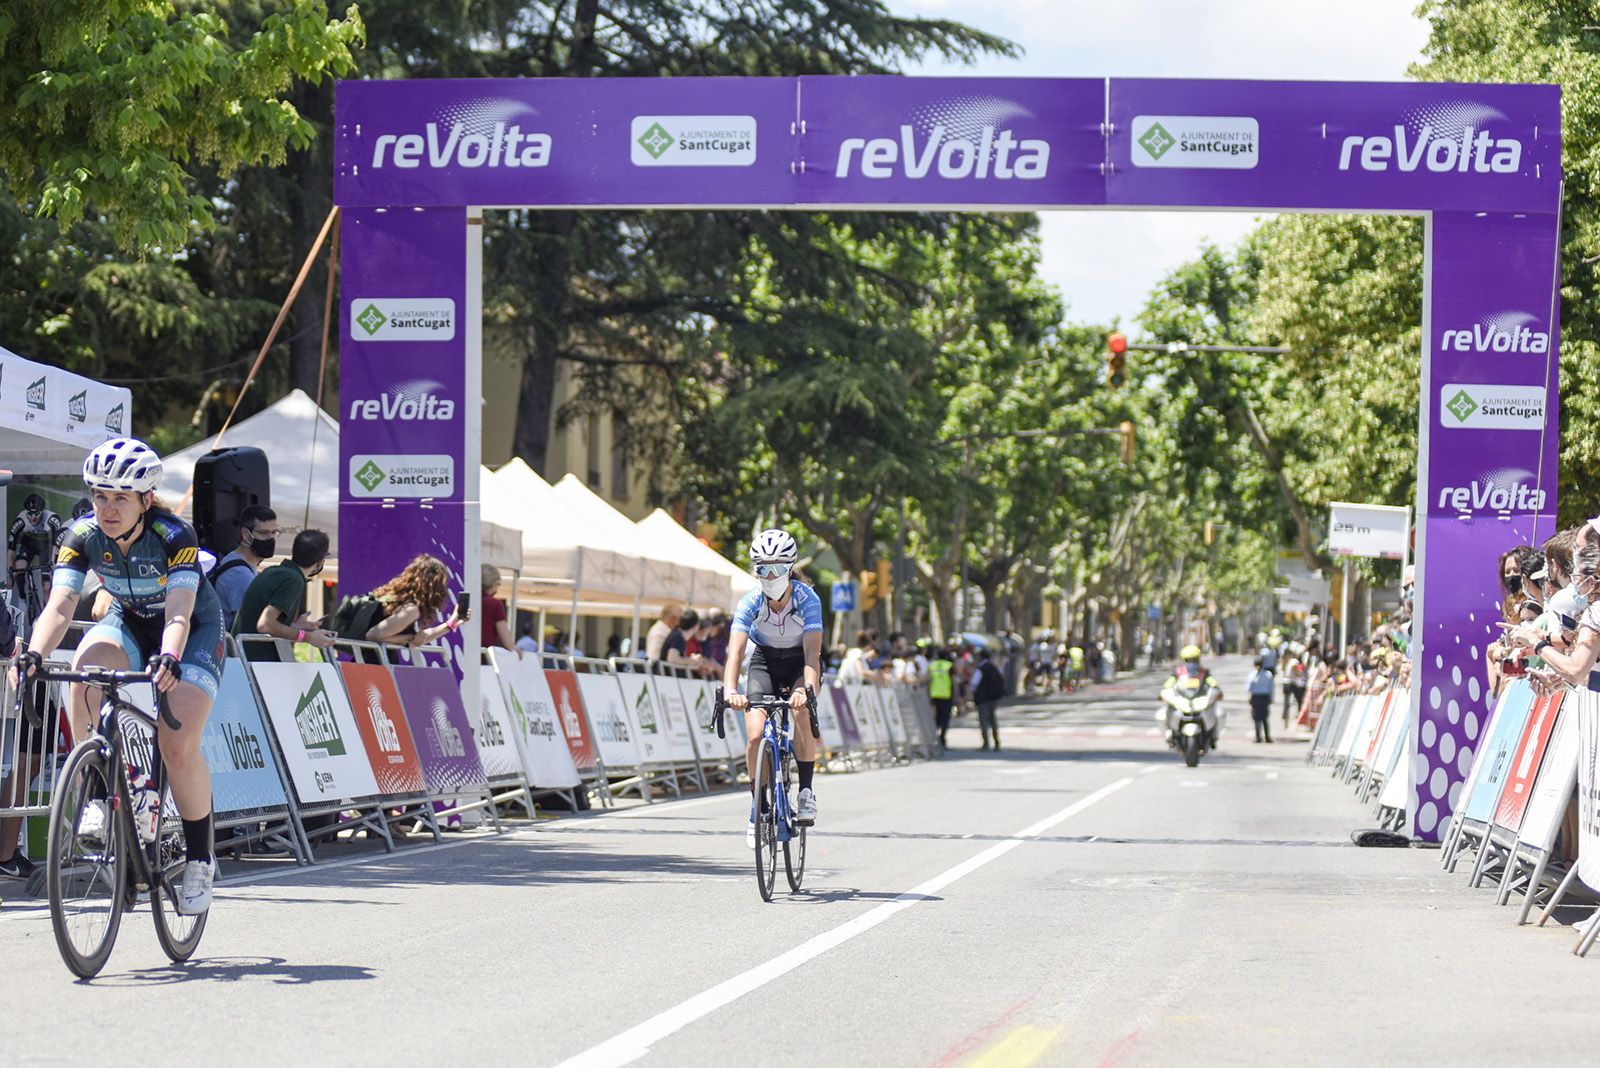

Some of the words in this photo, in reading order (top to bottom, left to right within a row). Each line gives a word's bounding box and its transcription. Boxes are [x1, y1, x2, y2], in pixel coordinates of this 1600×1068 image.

[680, 130, 740, 140] AJUNTAMENT
[741, 130, 752, 139] DE
[1181, 131, 1242, 142] AJUNTAMENT
[1243, 132, 1254, 142] DE
[372, 121, 553, 169] reVolta
[679, 139, 752, 153] SantCugat
[1181, 141, 1254, 155] SantCugat
[1338, 125, 1522, 173] reVolta
[836, 124, 1050, 180] reVolta
[391, 310, 439, 318] AJUNTAMENT
[441, 310, 451, 318] DE
[390, 318, 451, 330] SantCugat
[1441, 323, 1549, 354] reVolta
[350, 392, 455, 421] reVolta
[1482, 398, 1532, 406] AJUNTAMENT
[1533, 399, 1544, 407] DE
[1481, 406, 1543, 419] SantCugat
[389, 467, 439, 475] AJUNTAMENT
[440, 467, 450, 475] DE
[389, 475, 450, 487] SantCugat
[1438, 480, 1546, 510] reVolta
[1333, 522, 1355, 533] 25
